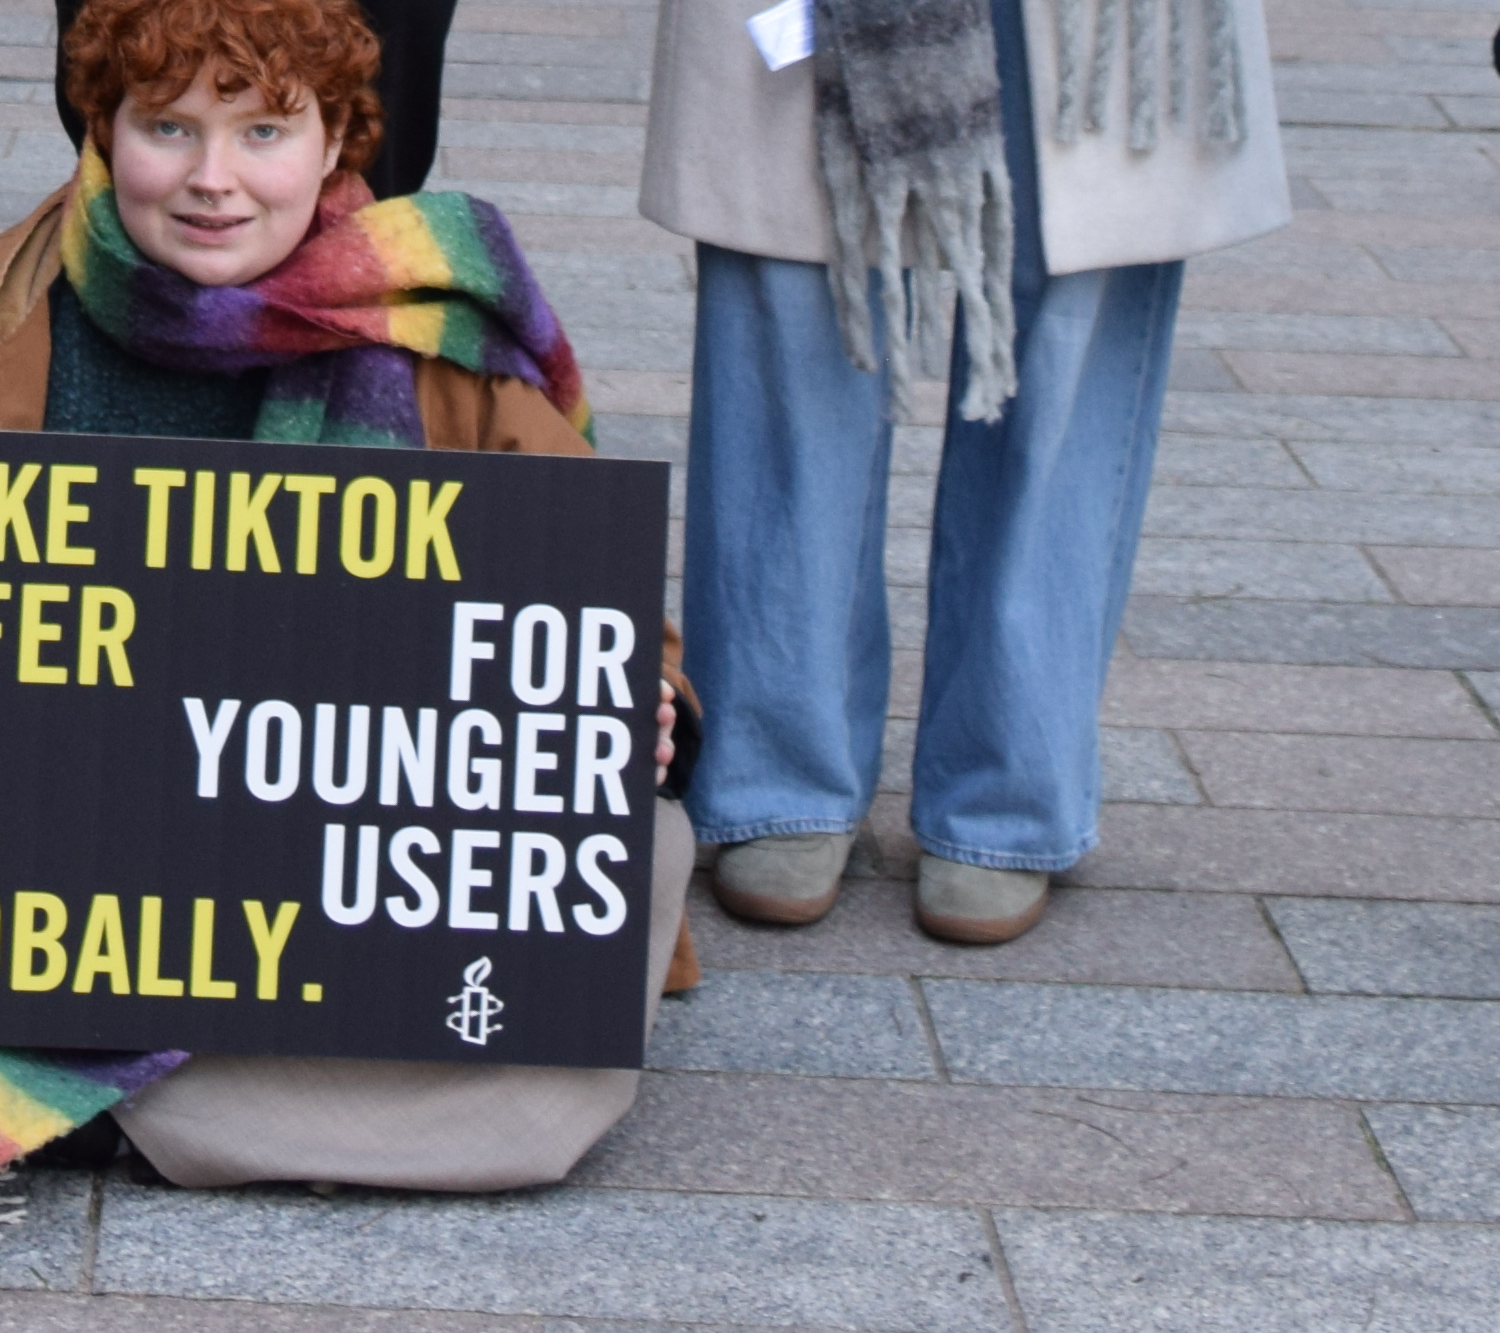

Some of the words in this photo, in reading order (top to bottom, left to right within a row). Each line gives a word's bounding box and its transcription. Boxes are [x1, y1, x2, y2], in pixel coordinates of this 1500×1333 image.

[134, 468, 463, 581] TIKTOK
[450, 601, 636, 709] FOR
[182, 697, 632, 816] YOUNGER
[322, 823, 629, 936] USERS
